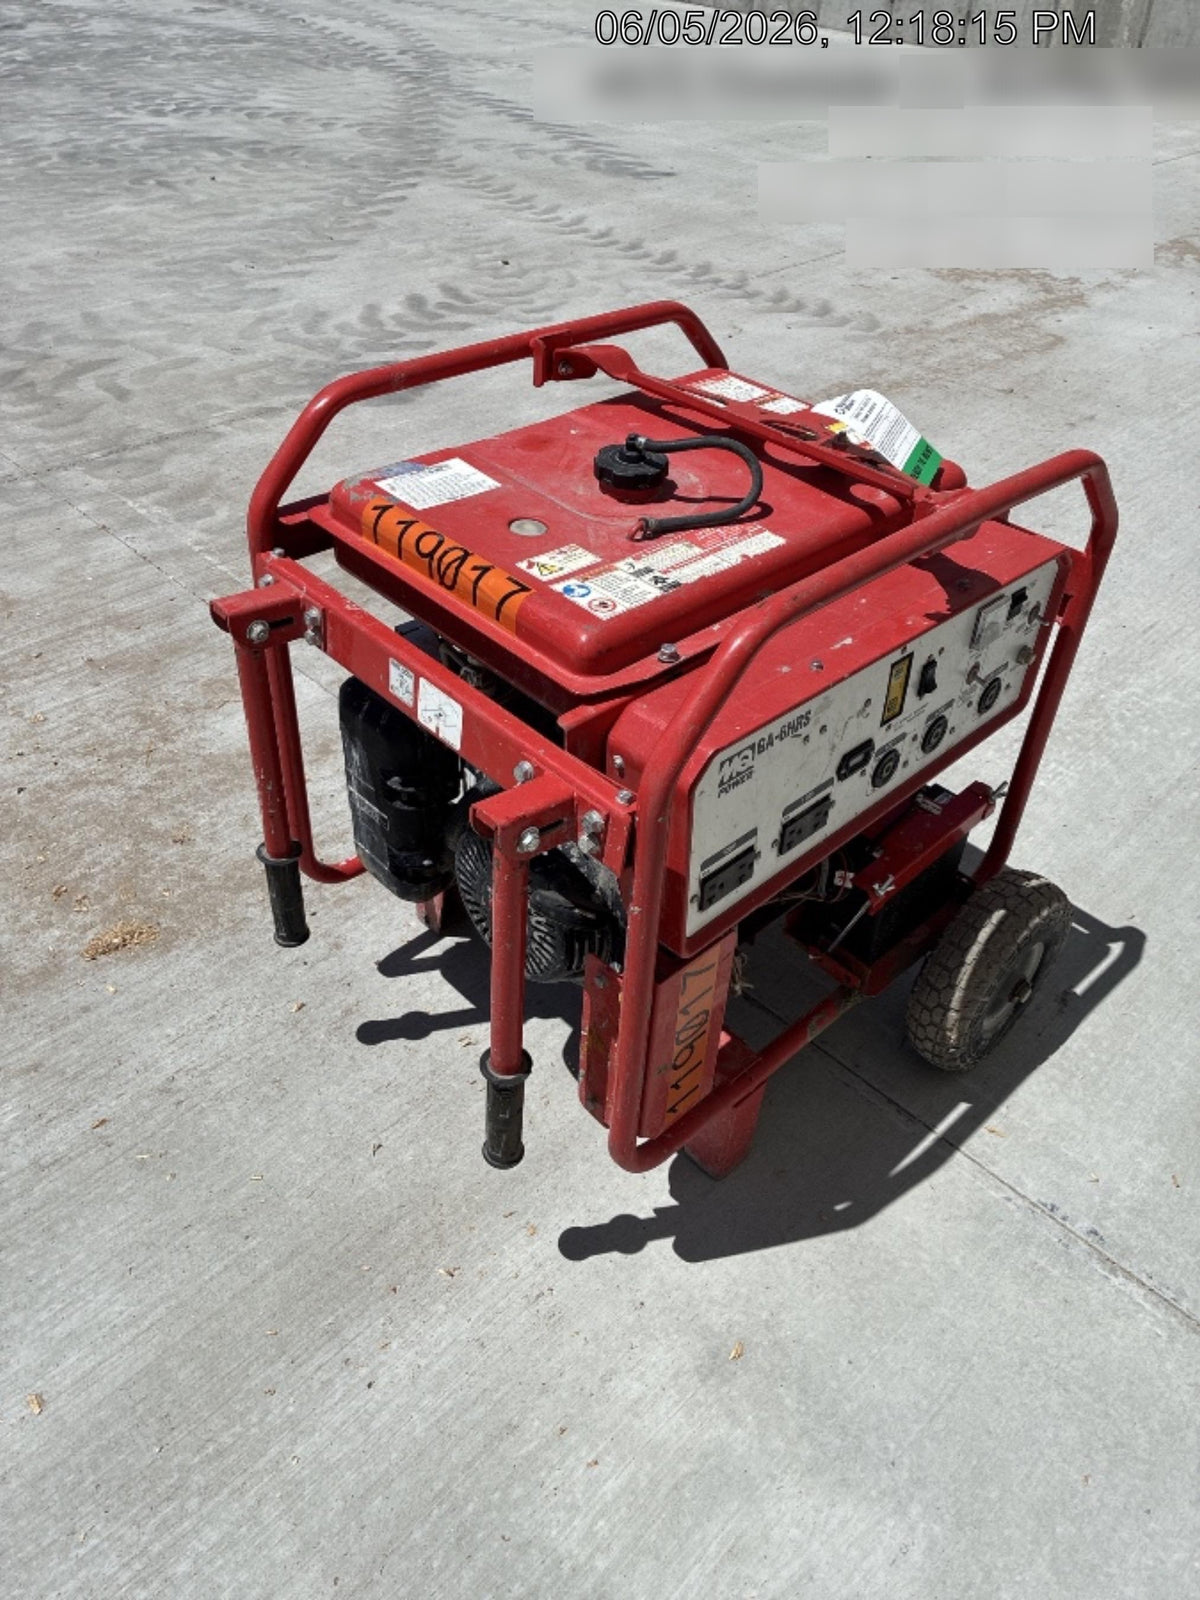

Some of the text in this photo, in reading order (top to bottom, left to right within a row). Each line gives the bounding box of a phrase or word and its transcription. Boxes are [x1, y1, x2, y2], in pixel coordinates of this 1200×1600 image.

[371, 504, 533, 622] 119017
[717, 770, 754, 799] POWER
[665, 963, 716, 1114] 119017
